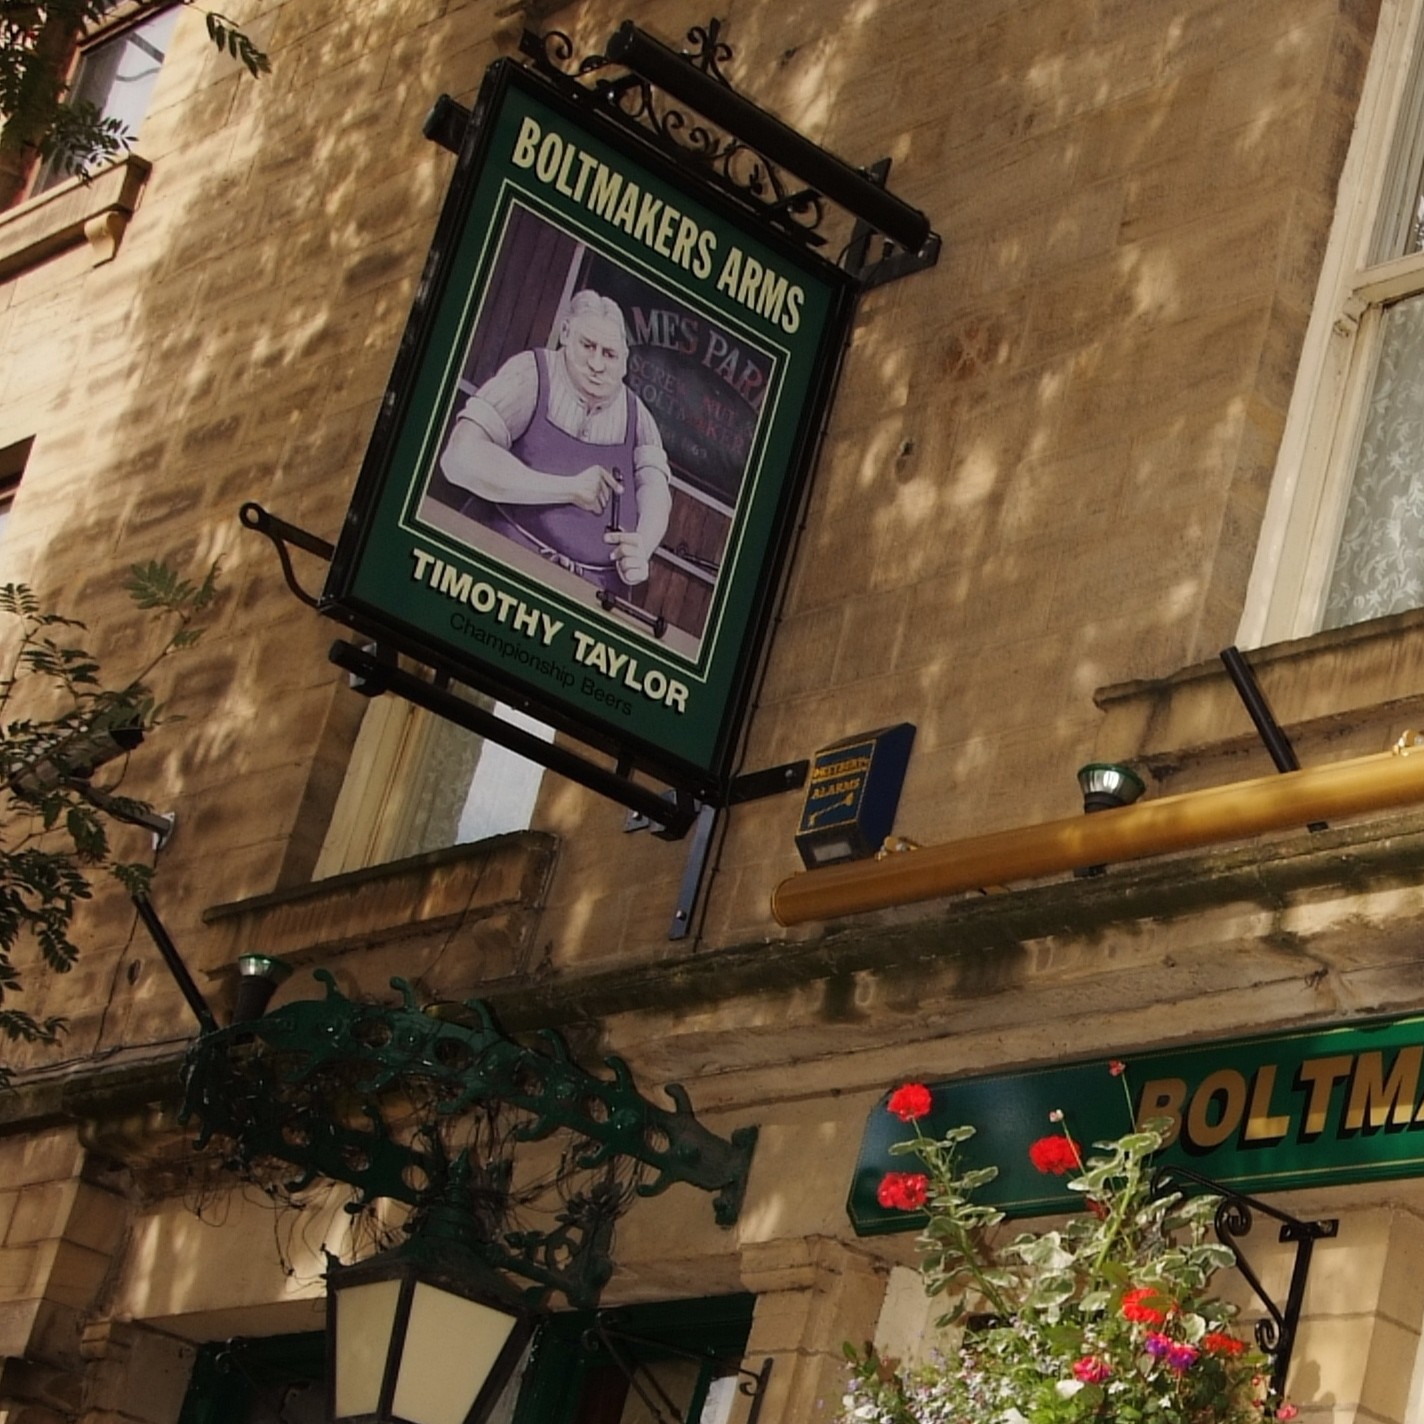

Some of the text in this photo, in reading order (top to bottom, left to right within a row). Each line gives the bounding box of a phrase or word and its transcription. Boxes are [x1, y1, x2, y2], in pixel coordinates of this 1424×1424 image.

[510, 116, 805, 334] BOLTMAKERS ARMS
[411, 548, 690, 714] TIMOTHY TAYLOR
[449, 611, 634, 717] Championship Beers
